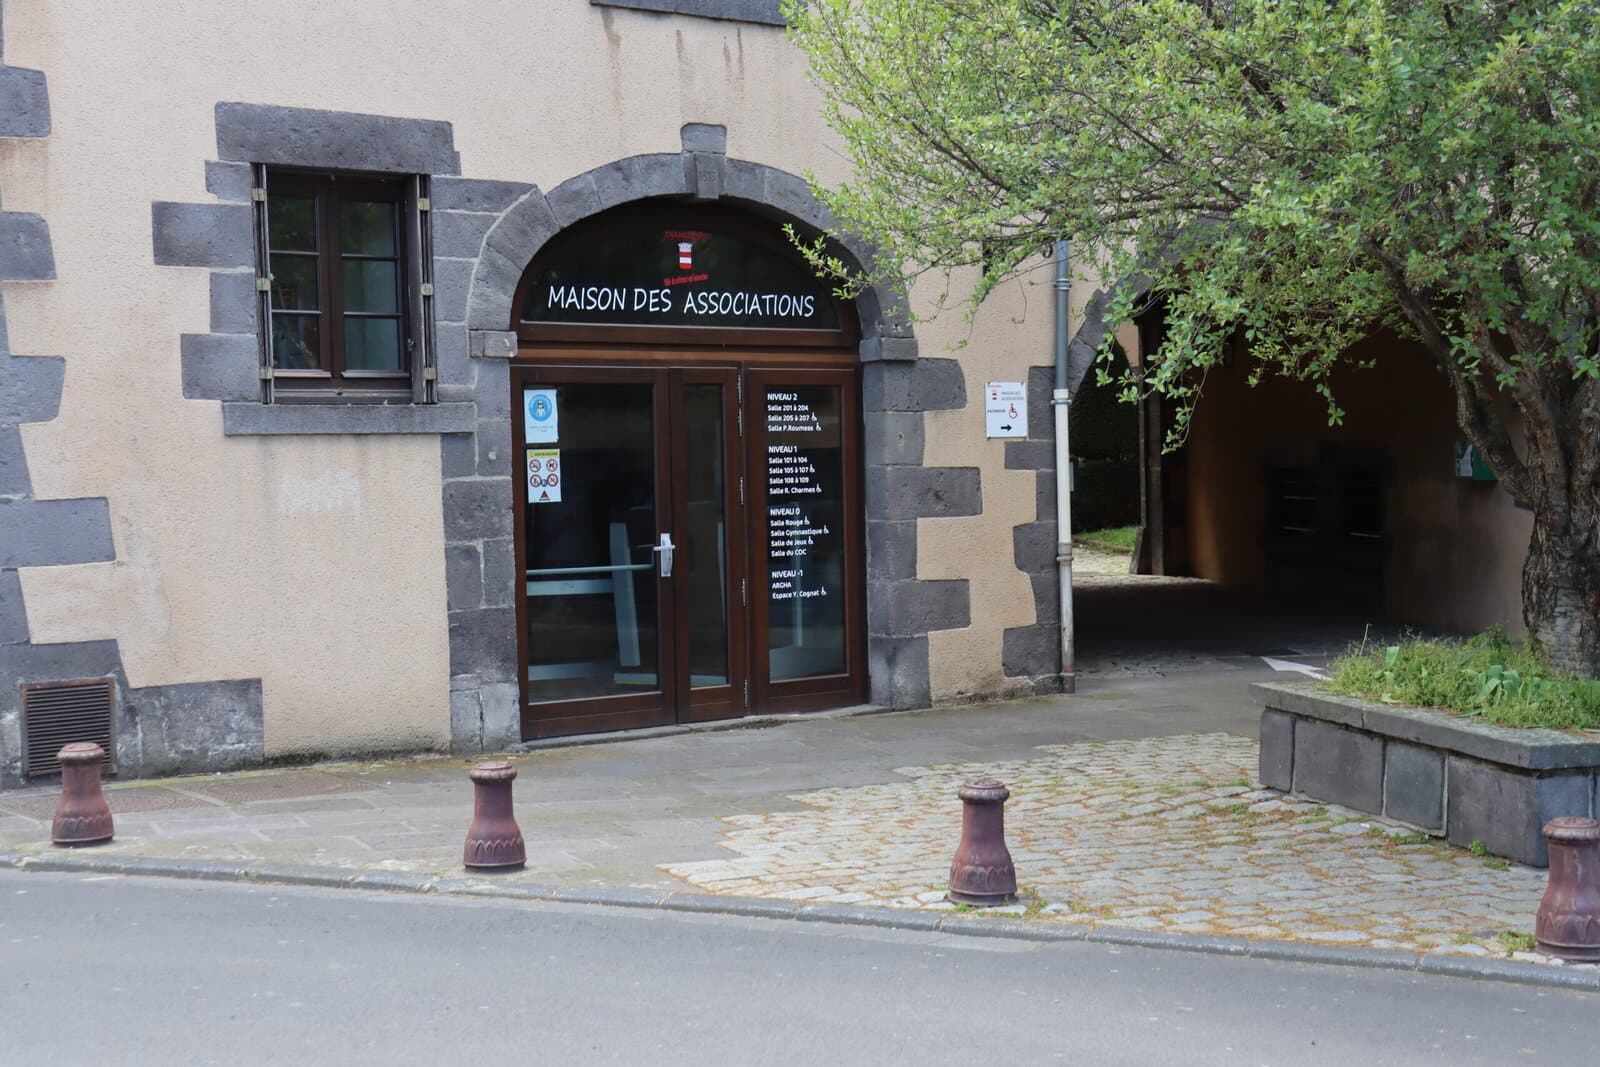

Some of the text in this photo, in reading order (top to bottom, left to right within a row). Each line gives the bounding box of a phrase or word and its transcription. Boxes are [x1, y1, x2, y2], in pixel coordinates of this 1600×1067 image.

[547, 285, 815, 318] MAISON DES ASSOCIATIONS
[767, 393, 798, 401] NIVEAU 2
[768, 445, 798, 453] NIVEAU 1
[769, 487, 784, 495] Salle
[770, 507, 801, 516] NIVEAU 0
[785, 519, 804, 527] Rouge
[785, 528, 823, 537] Gymnastique
[794, 548, 807, 556] COC
[772, 569, 804, 579] NIVEAU -1
[772, 592, 792, 600] Espace
[799, 590, 820, 598] Cognat
